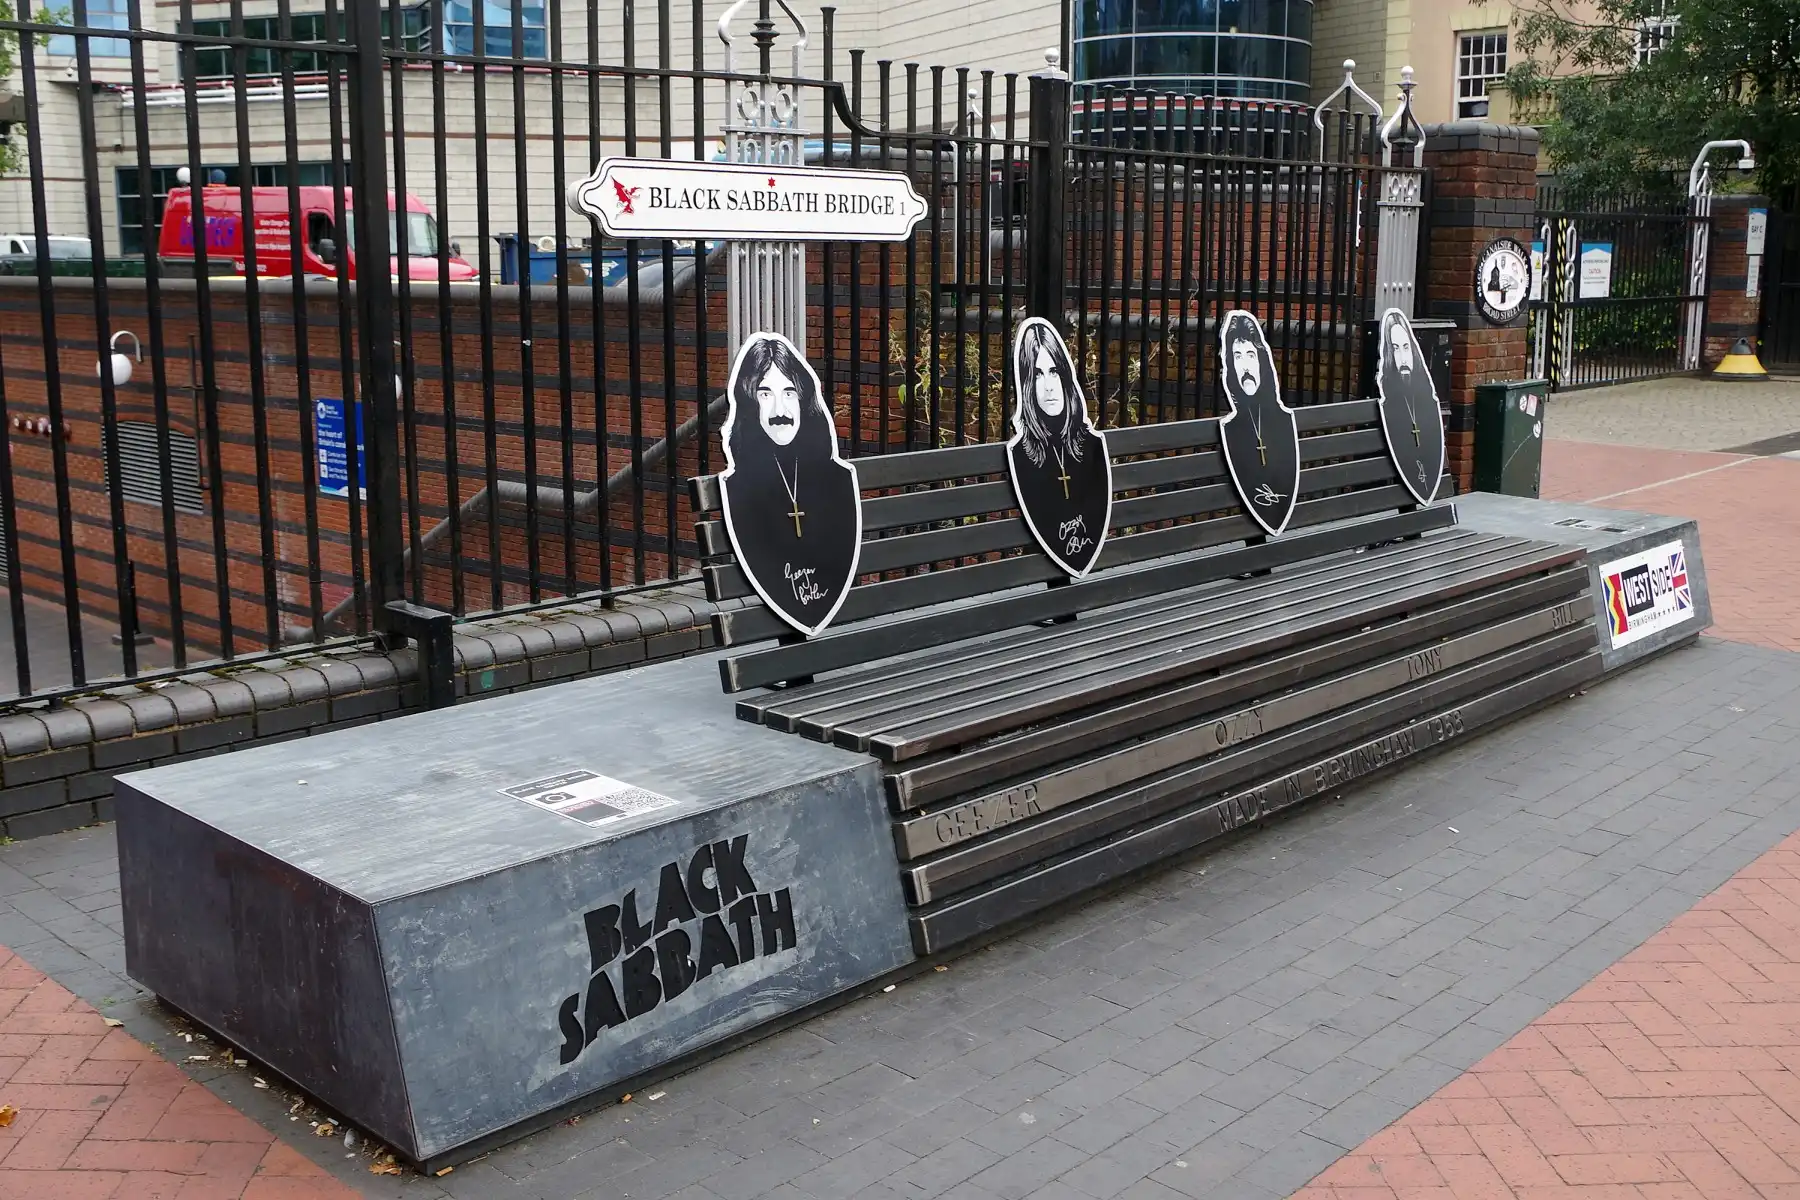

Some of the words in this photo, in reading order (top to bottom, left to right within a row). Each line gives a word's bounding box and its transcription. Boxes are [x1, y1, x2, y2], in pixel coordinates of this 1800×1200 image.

[648, 186, 721, 210] BLACK
[726, 189, 819, 213] SABBATH
[824, 193, 895, 215] BRIDGE
[899, 201, 906, 216] 1
[1482, 240, 1513, 263] CANALSIDE
[1513, 244, 1528, 264] WALK
[1482, 302, 1500, 320] BROAD
[1500, 303, 1520, 320] STREET
[1551, 602, 1578, 630] BILL
[1628, 611, 1657, 630] BIRMINGHAM
[1403, 647, 1444, 680] TONY
[1213, 707, 1265, 746] OZZY
[1216, 786, 1272, 833] MADE
[1283, 773, 1303, 803] IN
[1313, 726, 1419, 793] BIRMINGHAM
[1425, 709, 1465, 742] 1968
[936, 783, 1042, 845] GEEZER
[583, 833, 758, 976] BLACK
[558, 886, 797, 1066] SABBATH
